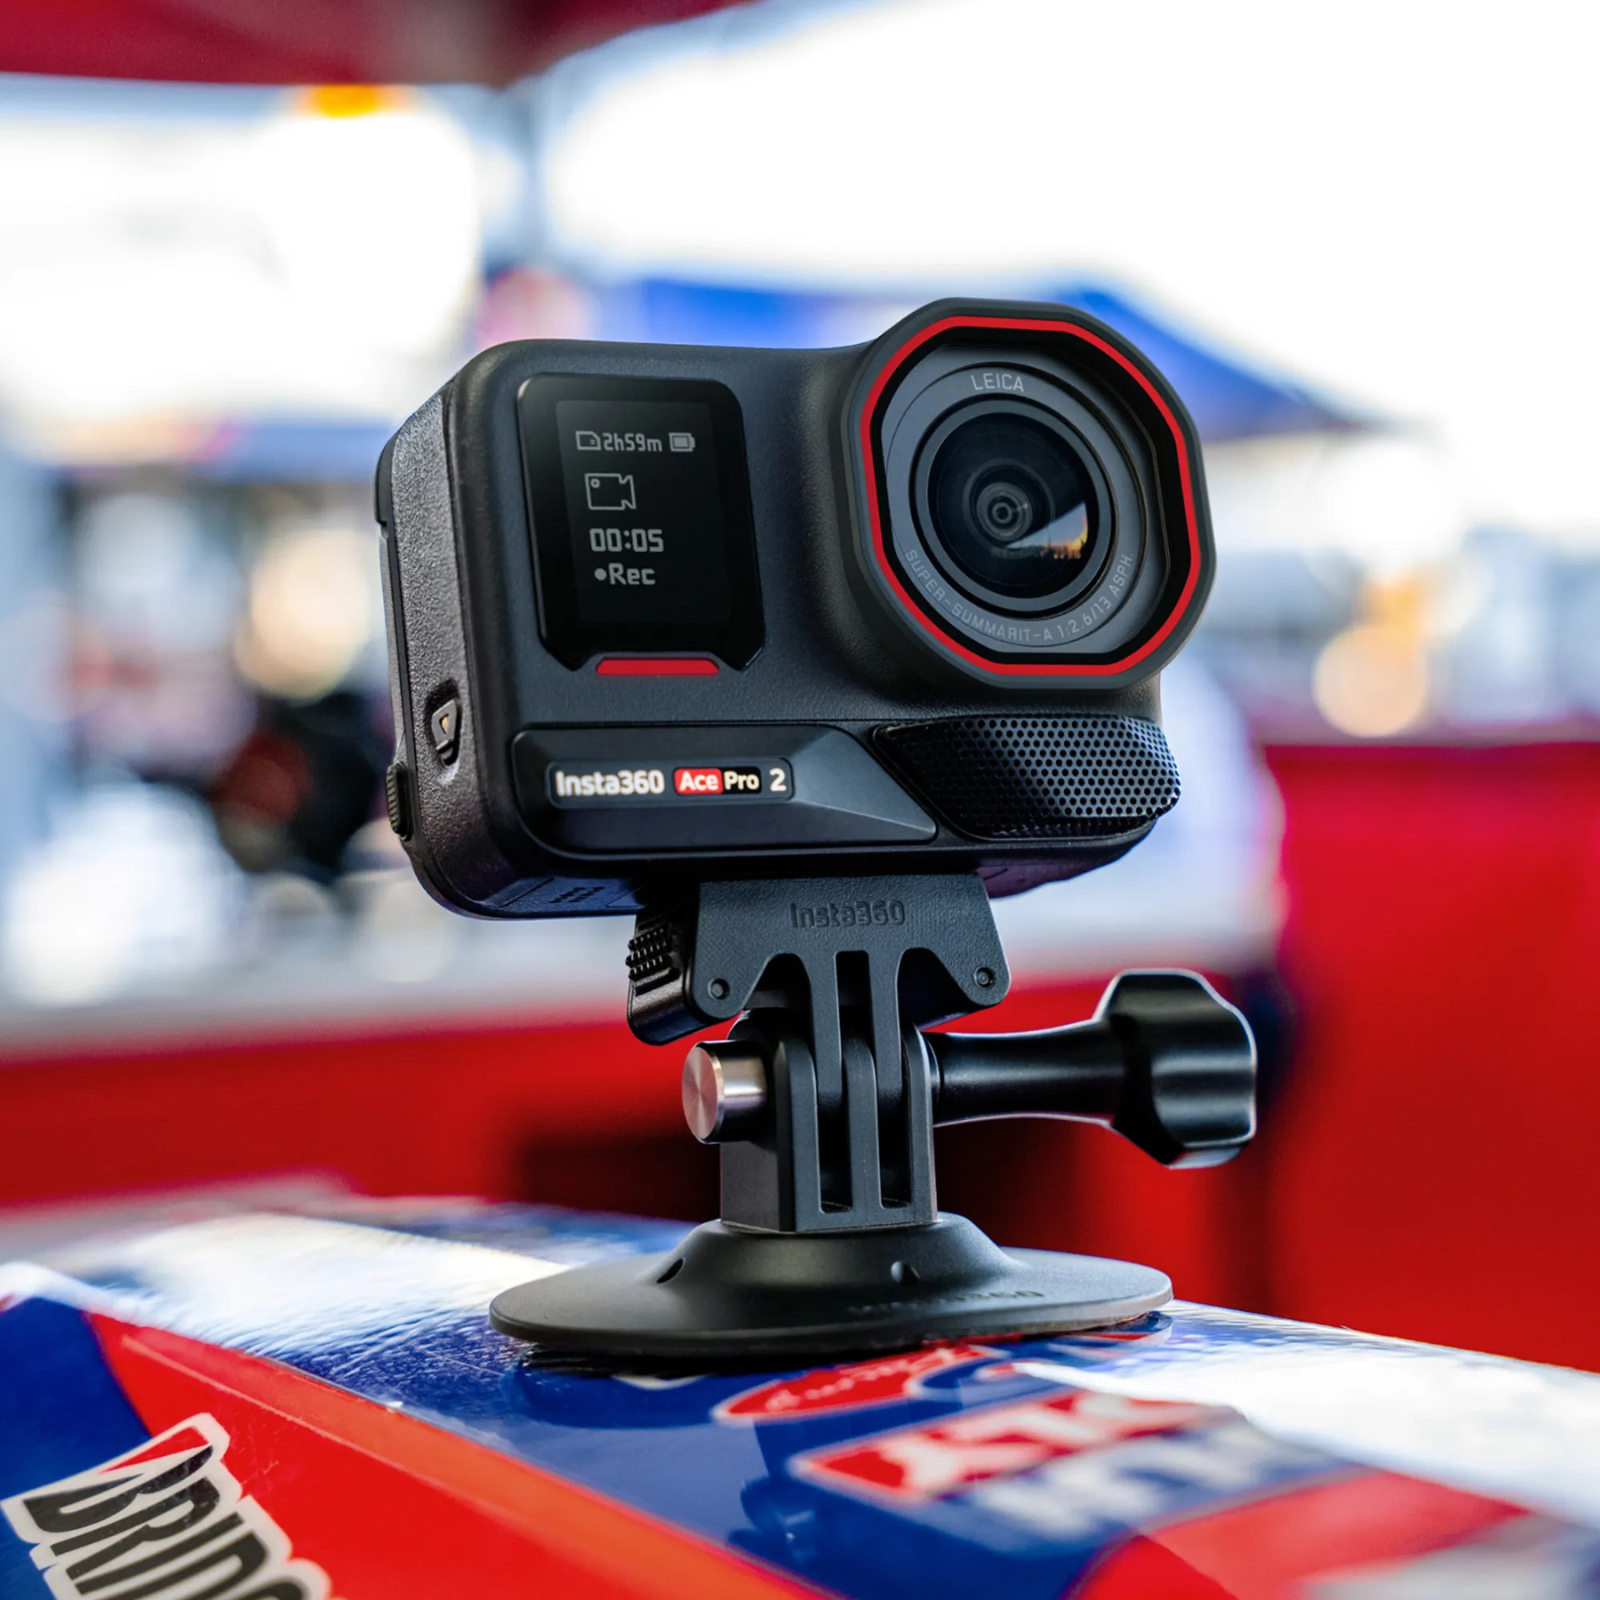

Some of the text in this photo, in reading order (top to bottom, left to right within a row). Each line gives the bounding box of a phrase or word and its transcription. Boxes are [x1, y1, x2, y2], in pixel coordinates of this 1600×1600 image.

[970, 372, 1025, 393] LEICA
[602, 432, 663, 452] 2h59m
[589, 527, 664, 552] 00:05
[608, 562, 656, 586] Rec
[1107, 551, 1135, 599] ASPH.
[554, 767, 788, 797] Insta360 Ace Pro 2
[789, 899, 906, 929] Insta360
